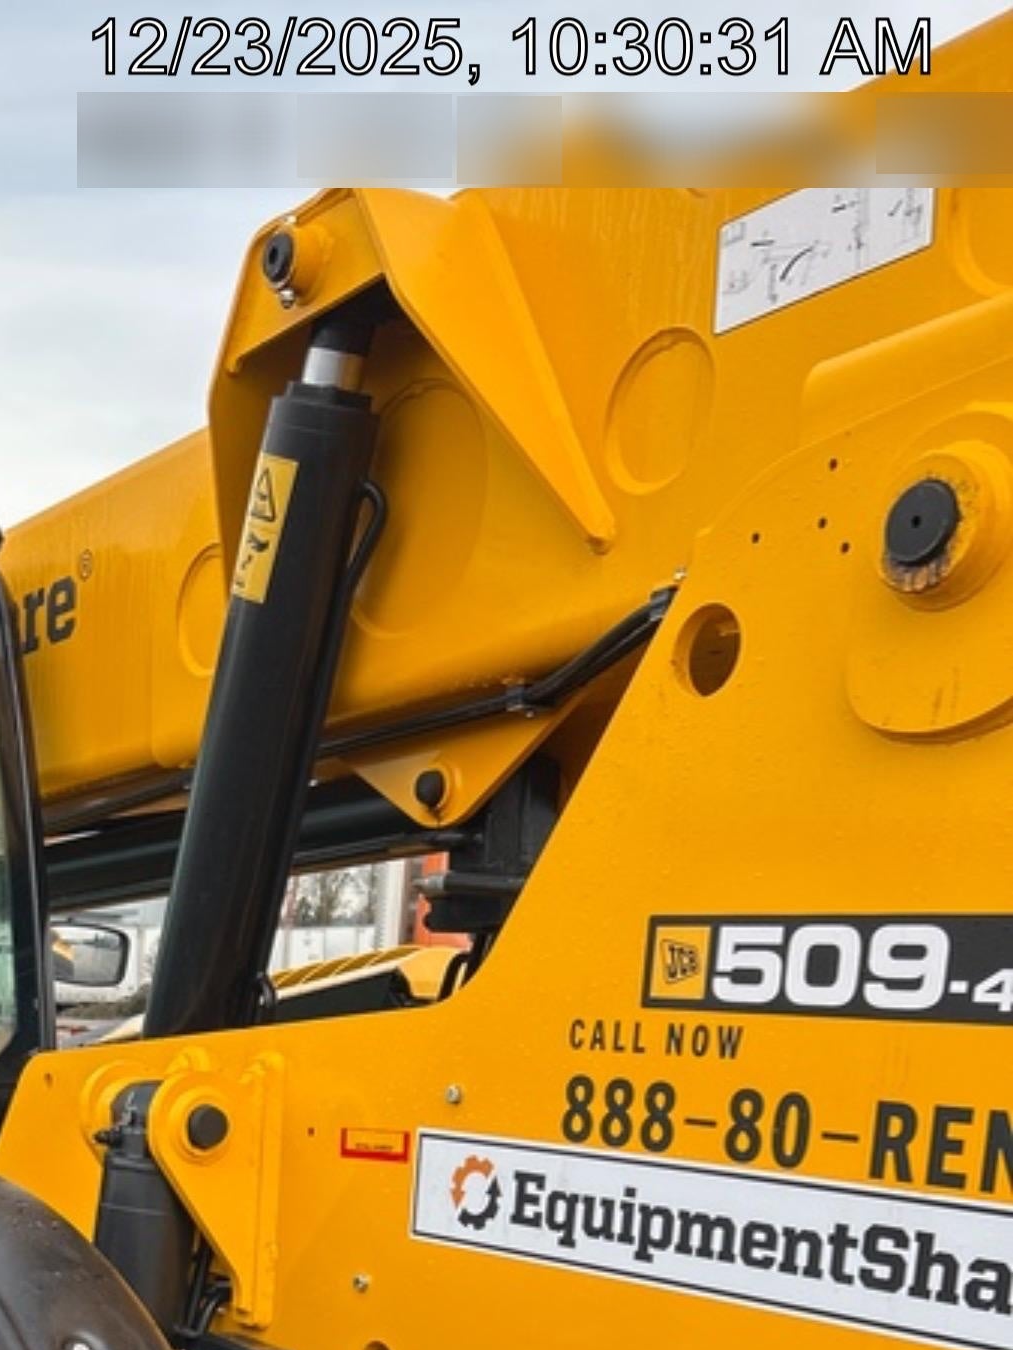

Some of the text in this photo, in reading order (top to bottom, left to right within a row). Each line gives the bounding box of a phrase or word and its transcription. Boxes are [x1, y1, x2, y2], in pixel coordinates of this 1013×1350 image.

[20, 576, 76, 655] re
[569, 1018, 745, 1060] CALL NOW
[508, 1169, 1013, 1316] EquipmentSha
